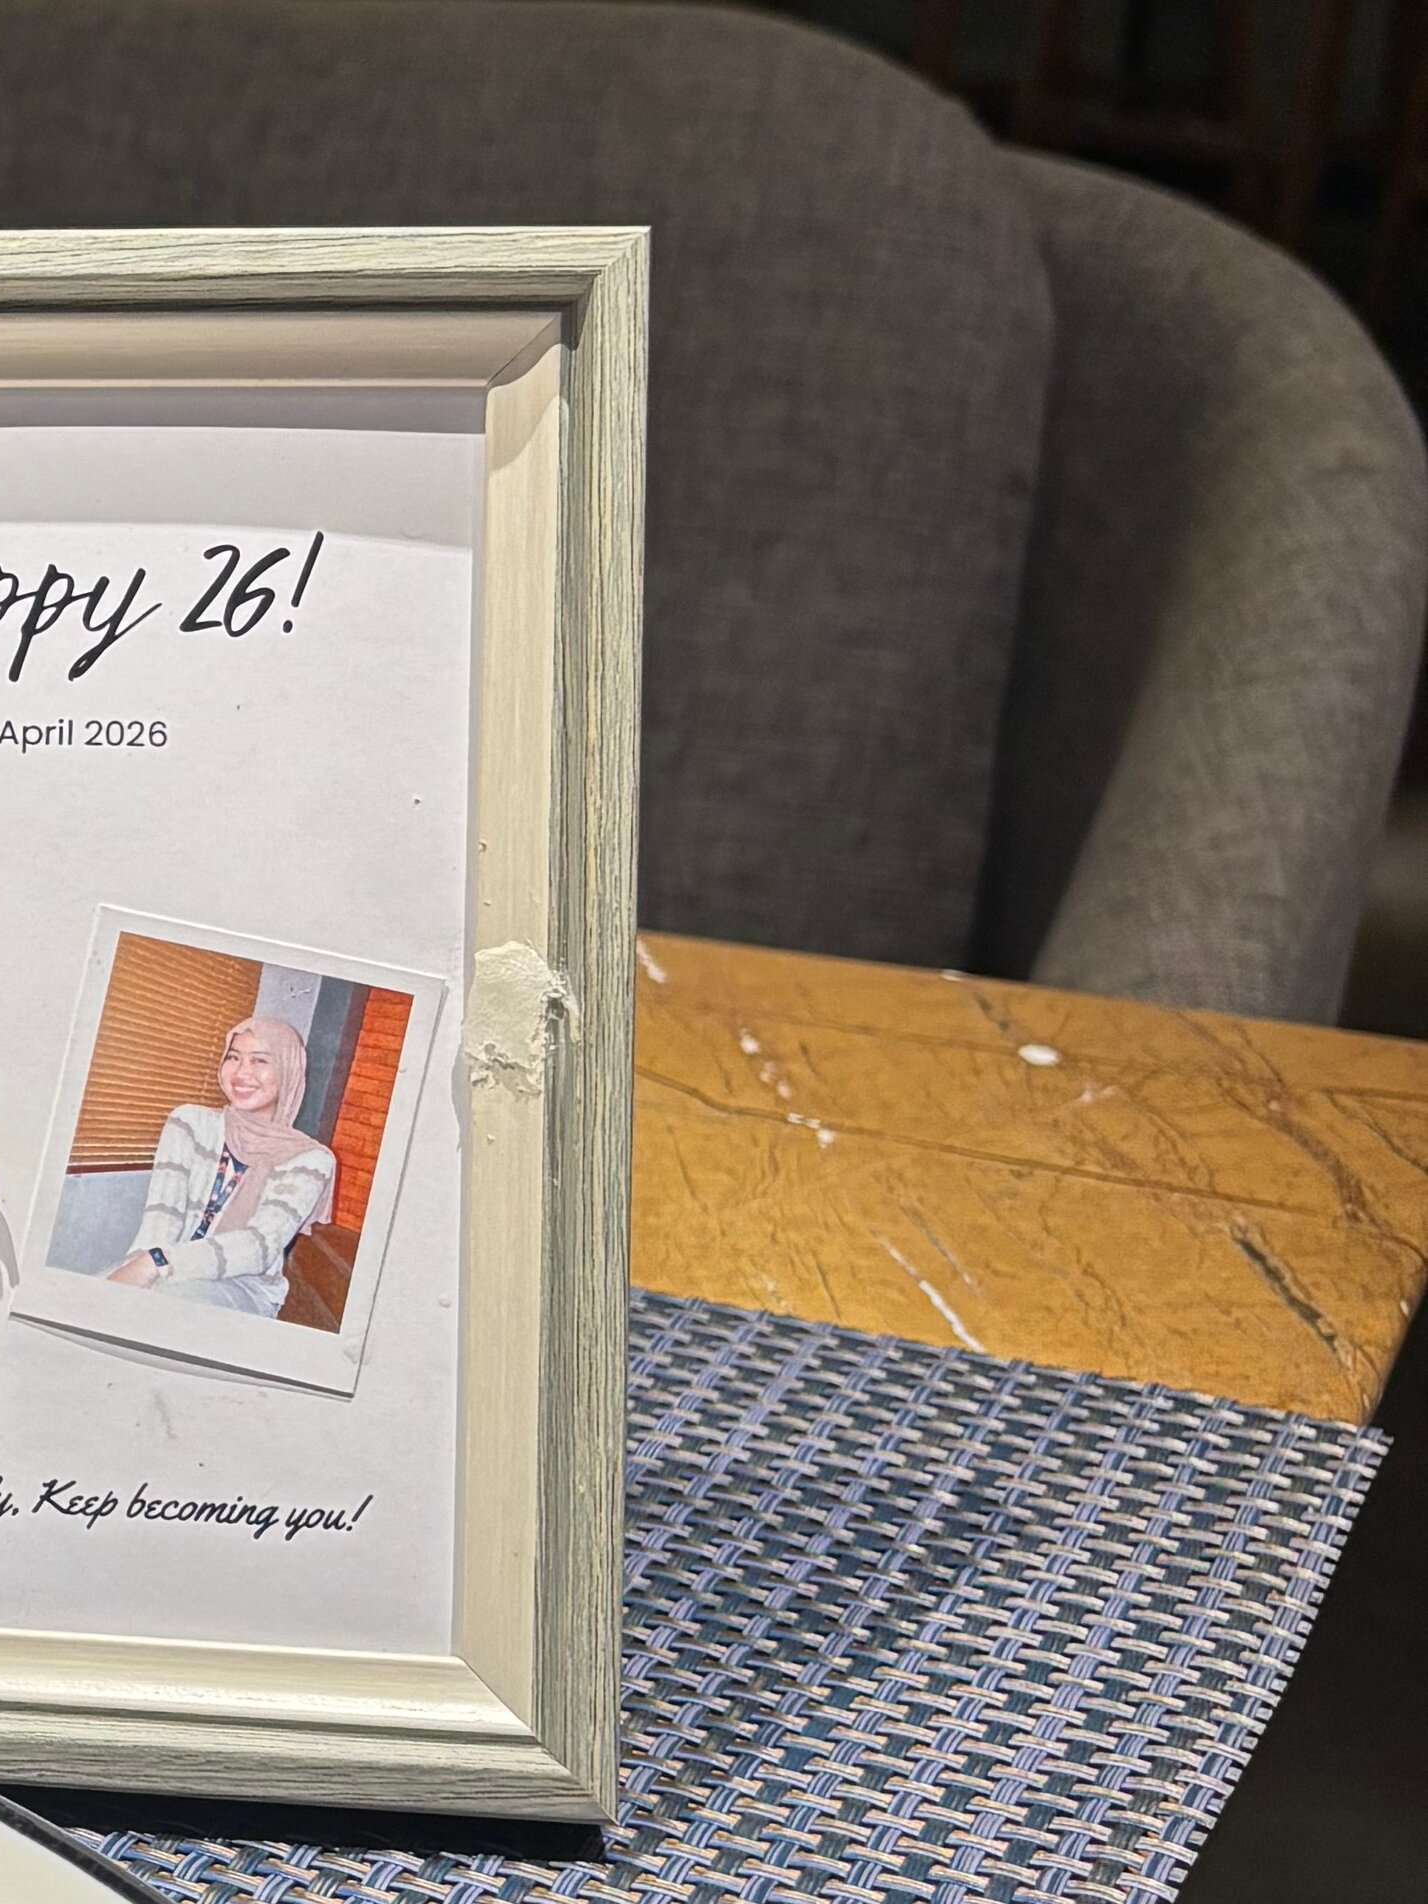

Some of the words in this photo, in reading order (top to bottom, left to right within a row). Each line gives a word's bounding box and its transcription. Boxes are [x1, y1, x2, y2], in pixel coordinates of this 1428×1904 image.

[178, 530, 325, 639] 26!
[83, 719, 169, 748] 2026
[30, 1478, 120, 1531] Keep
[125, 1481, 280, 1541] becoming
[283, 1493, 375, 1542] you!
